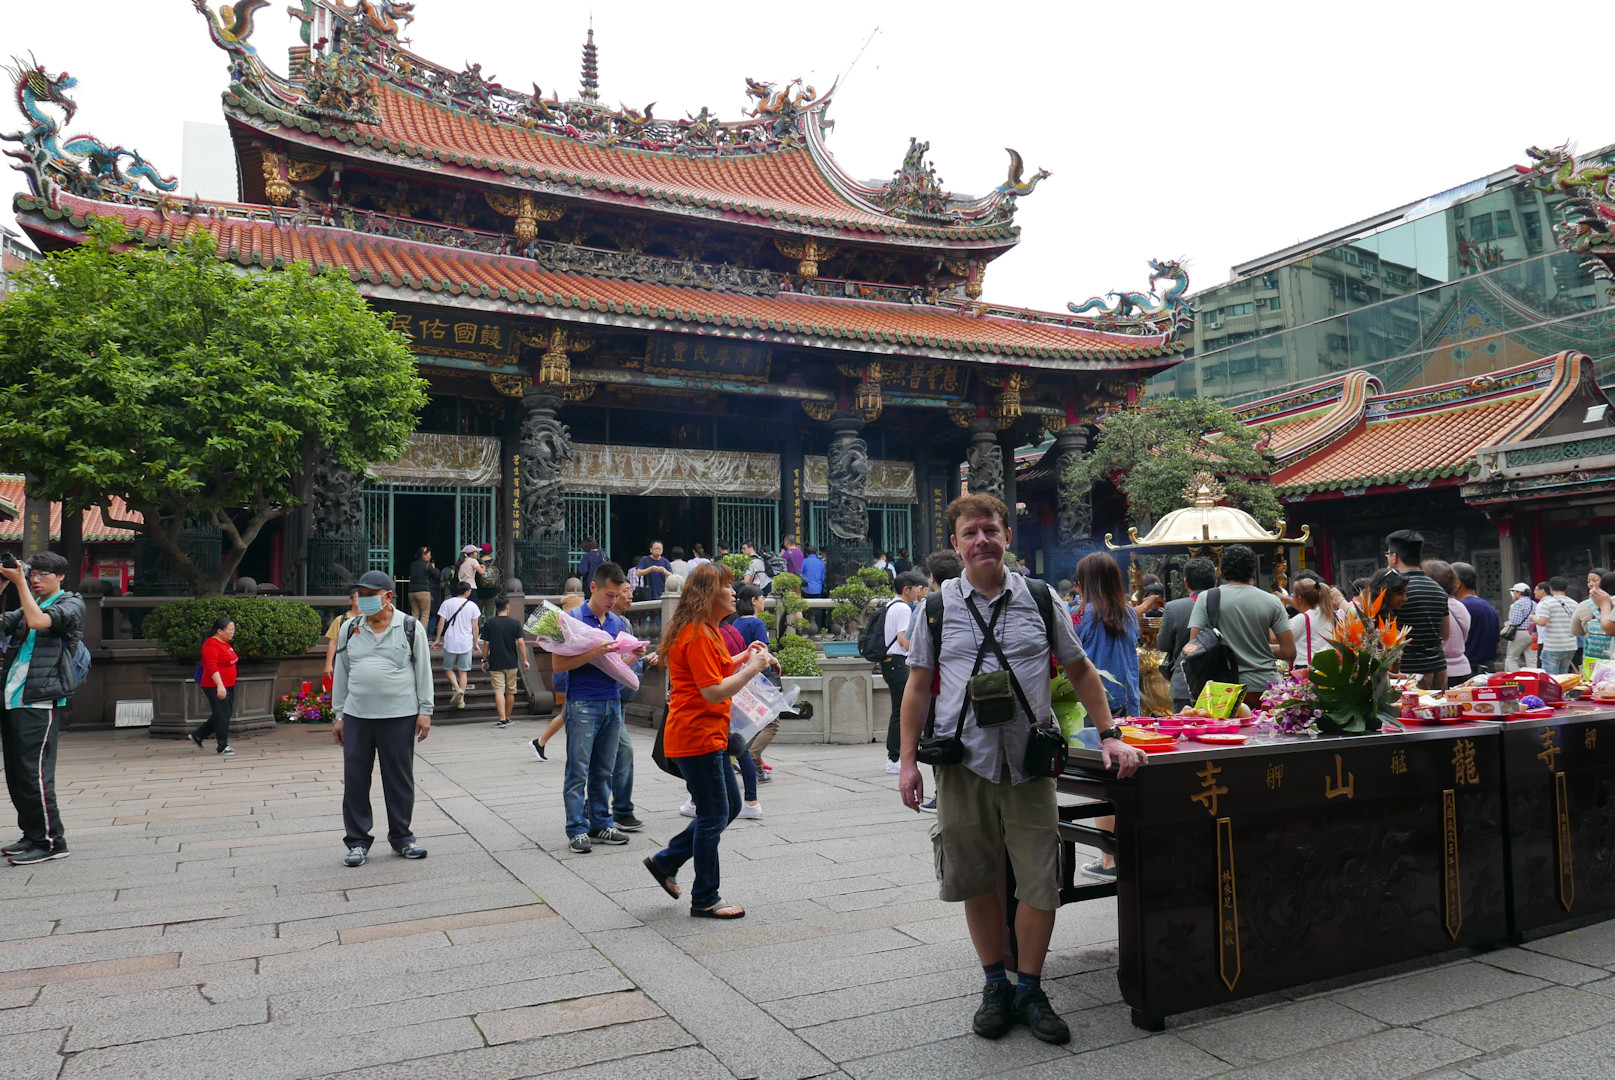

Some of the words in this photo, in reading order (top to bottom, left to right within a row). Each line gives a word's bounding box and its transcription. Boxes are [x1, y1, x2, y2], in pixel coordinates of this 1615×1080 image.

[1451, 739, 1480, 785] 龍
[1536, 726, 1562, 771] 寺
[1190, 760, 1229, 816] 寺
[1324, 753, 1355, 800] 山
